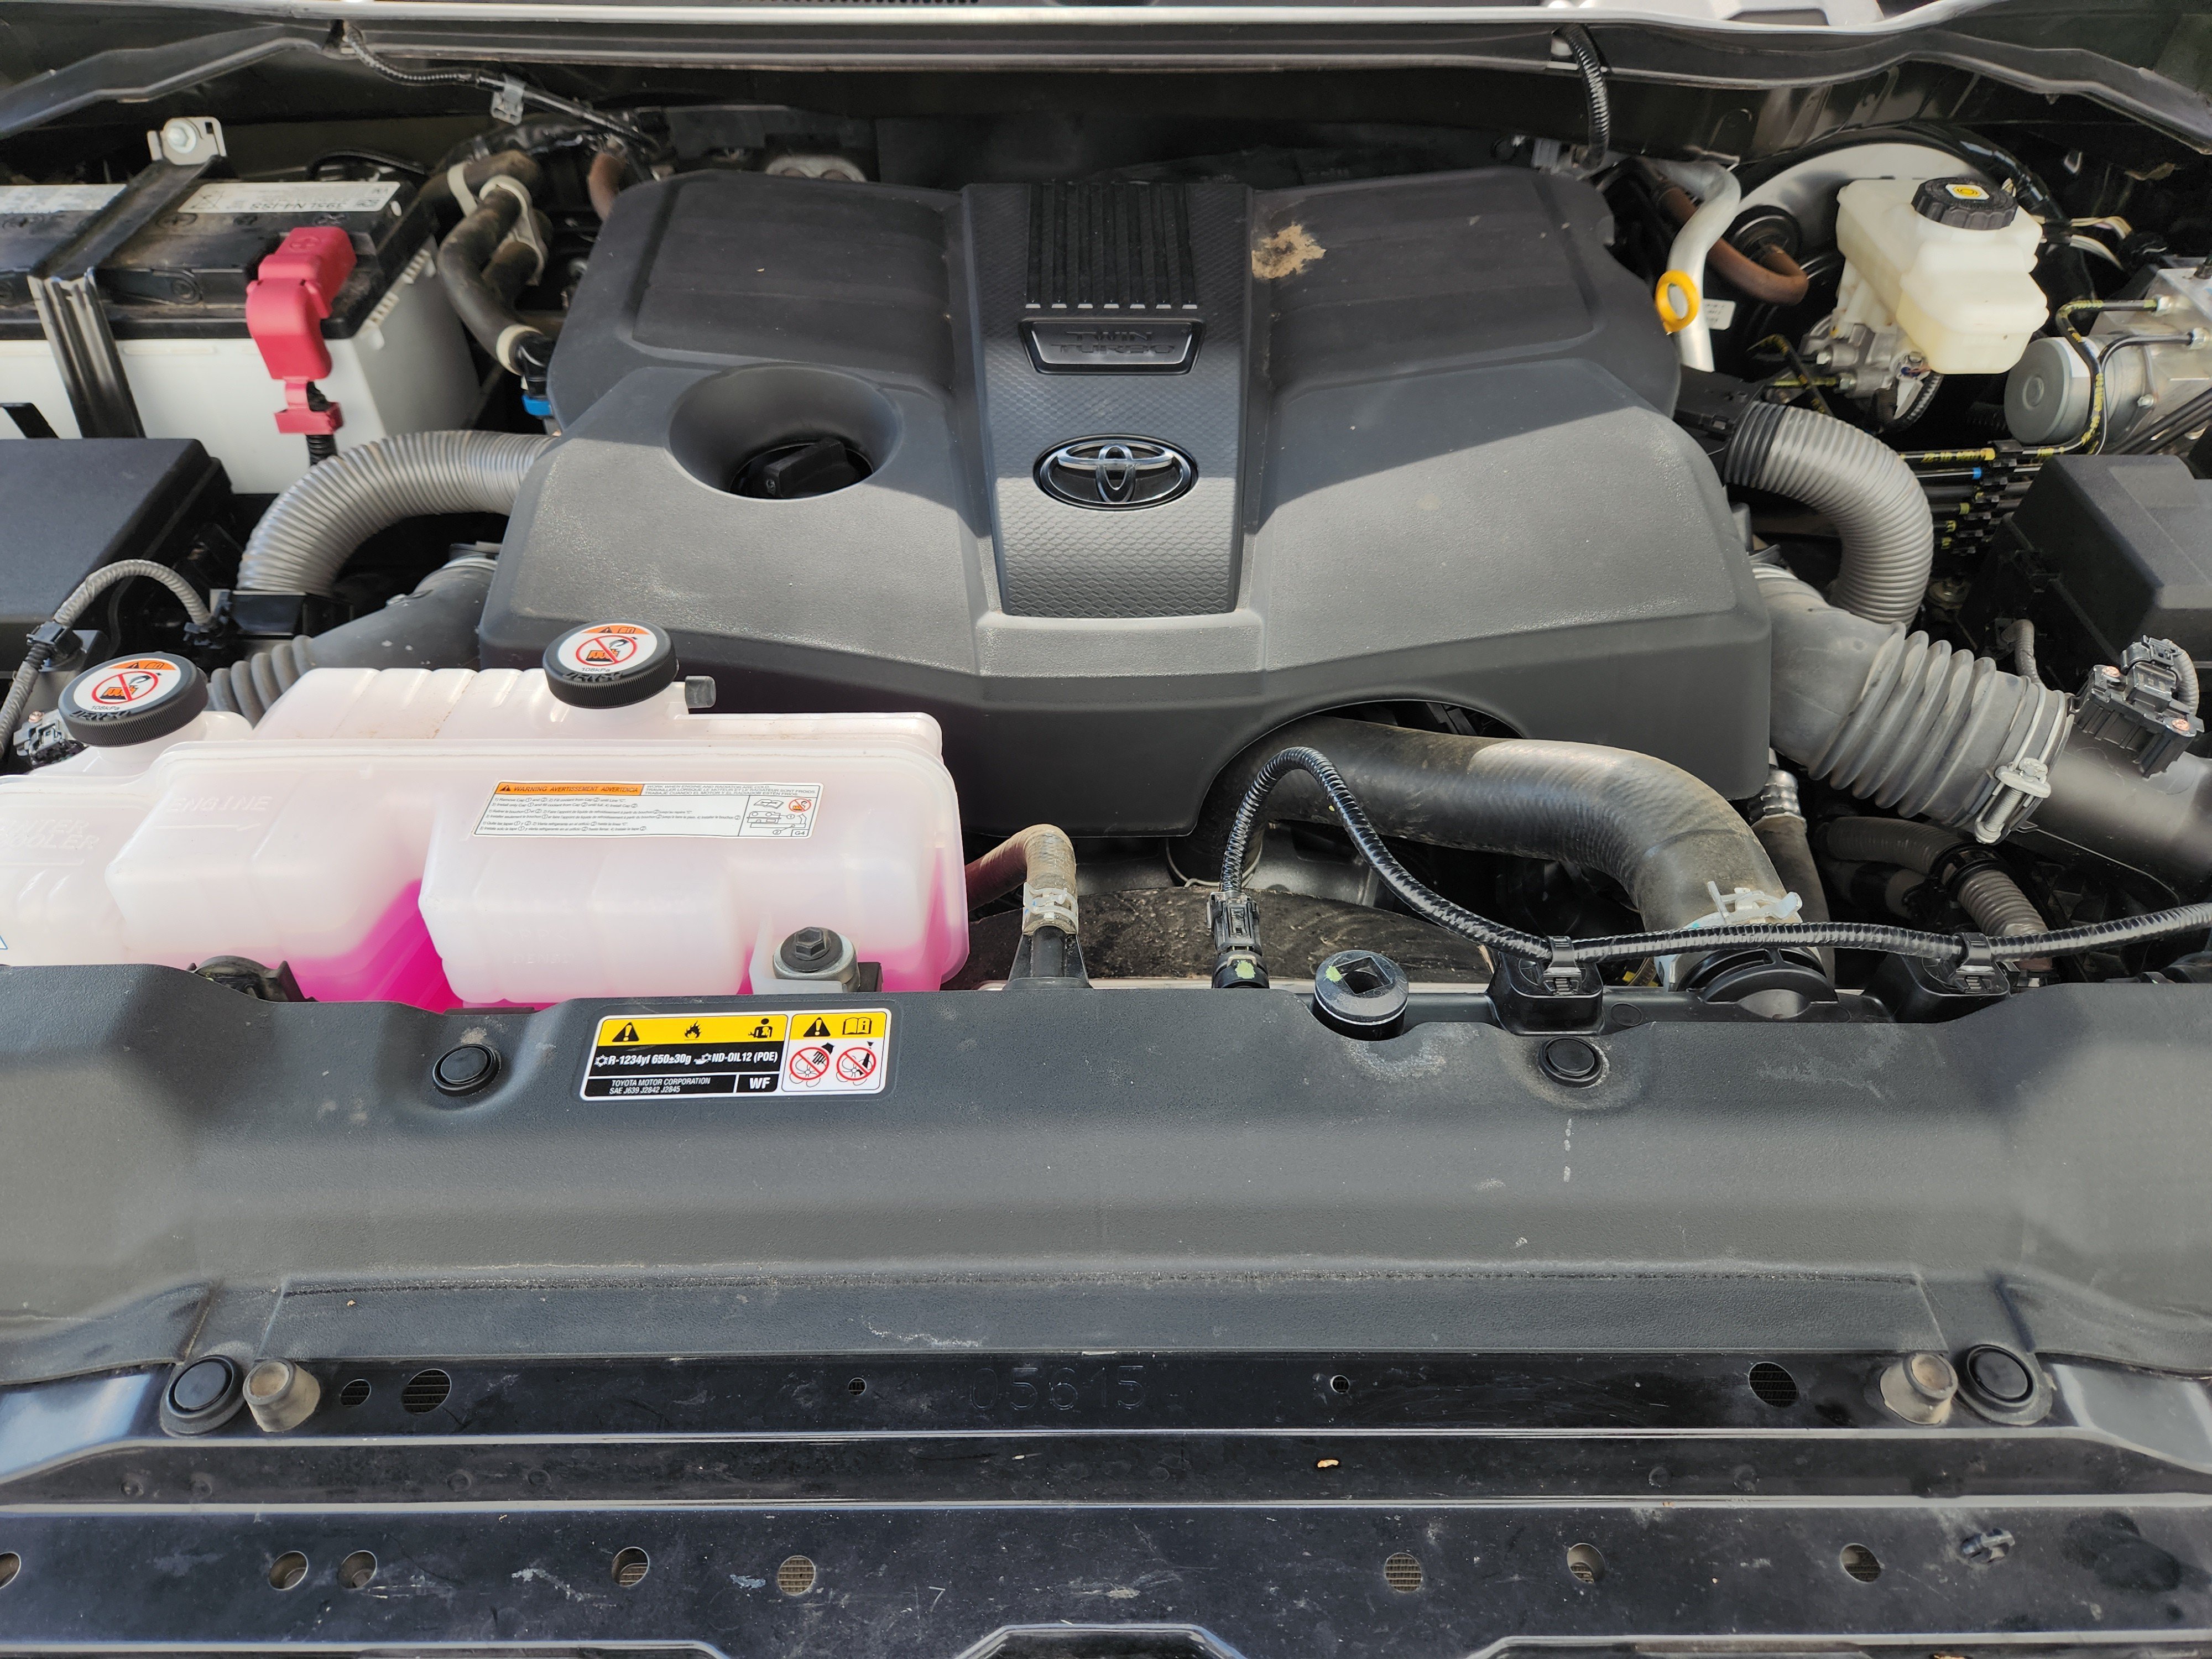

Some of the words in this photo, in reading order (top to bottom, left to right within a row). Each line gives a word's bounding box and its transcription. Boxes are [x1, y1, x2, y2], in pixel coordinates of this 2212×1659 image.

[1065, 331, 1152, 341] TWIN
[1051, 343, 1175, 353] TURBO
[563, 671, 624, 682] DENSO
[609, 1055, 651, 1067] R-1234yf
[651, 1053, 691, 1066] 650±30g
[711, 1052, 752, 1062] ND-OIL12
[754, 1051, 778, 1063] (POE)
[612, 1079, 637, 1087] TOYOTA
[663, 1077, 711, 1086] CORPORATION
[749, 1077, 771, 1089] WF
